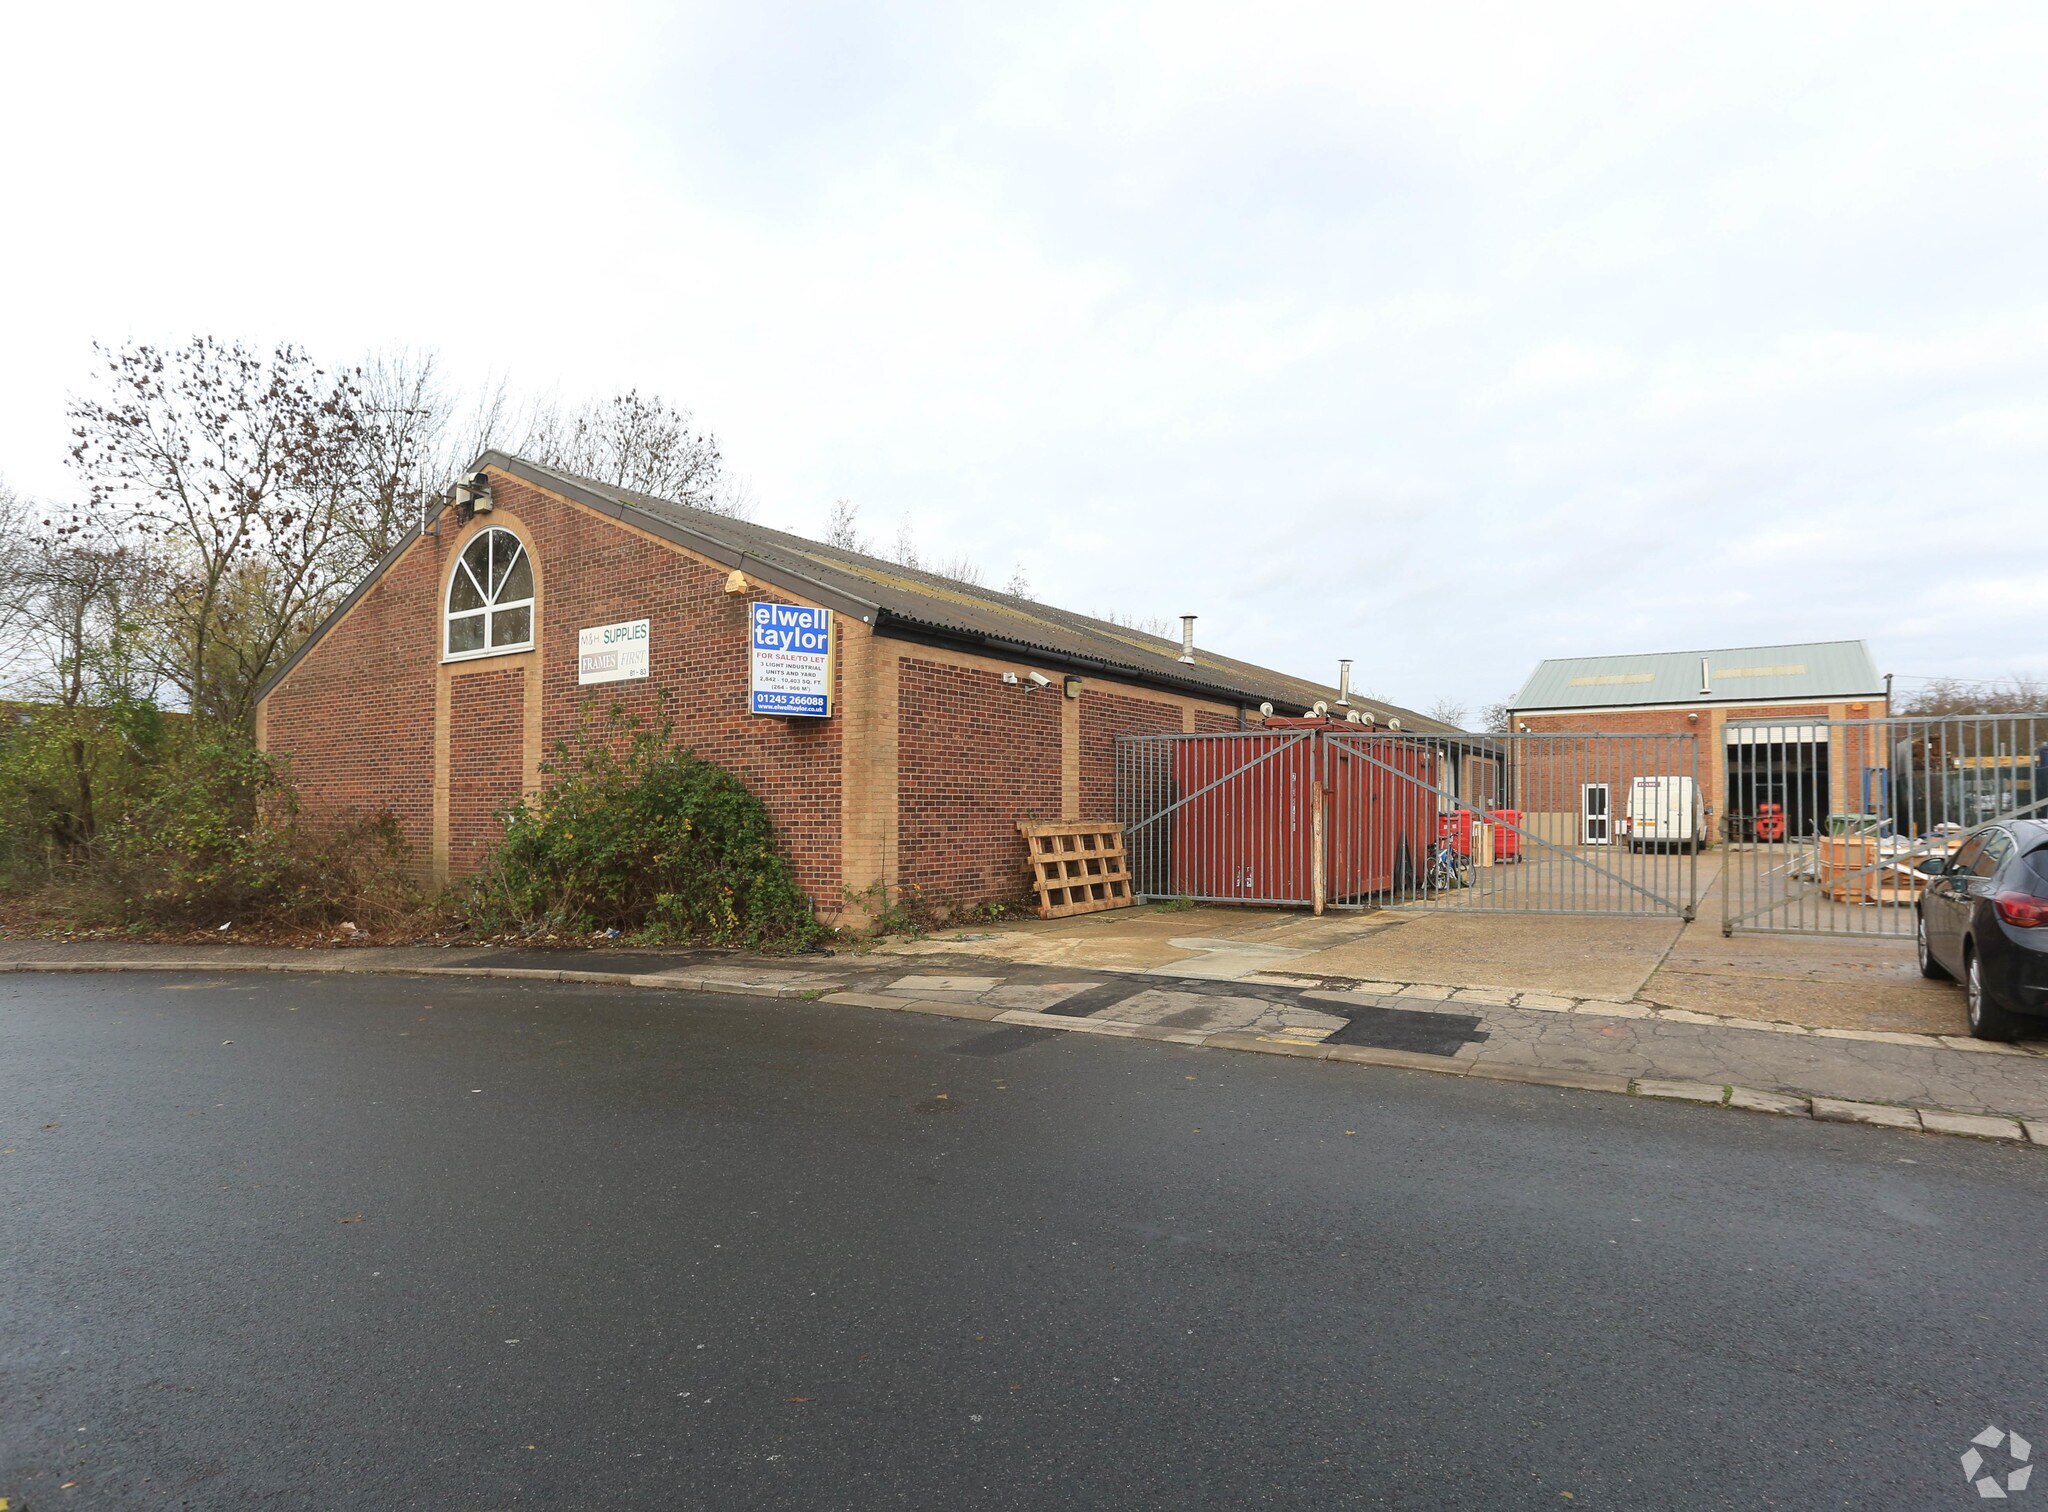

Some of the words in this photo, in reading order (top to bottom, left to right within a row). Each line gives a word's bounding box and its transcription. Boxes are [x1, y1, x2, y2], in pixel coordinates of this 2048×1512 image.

[756, 605, 826, 630] elwell
[581, 633, 600, 646] M&H
[604, 624, 646, 644] SUPPLIES
[755, 624, 827, 651] taylor
[582, 654, 616, 671] FRAMES
[621, 650, 646, 666] FIRST
[776, 654, 808, 662] SALE/TO
[758, 694, 786, 703] 01245
[789, 696, 824, 706] 266088
[758, 704, 823, 712] www.elwelltaylor.co.uk
